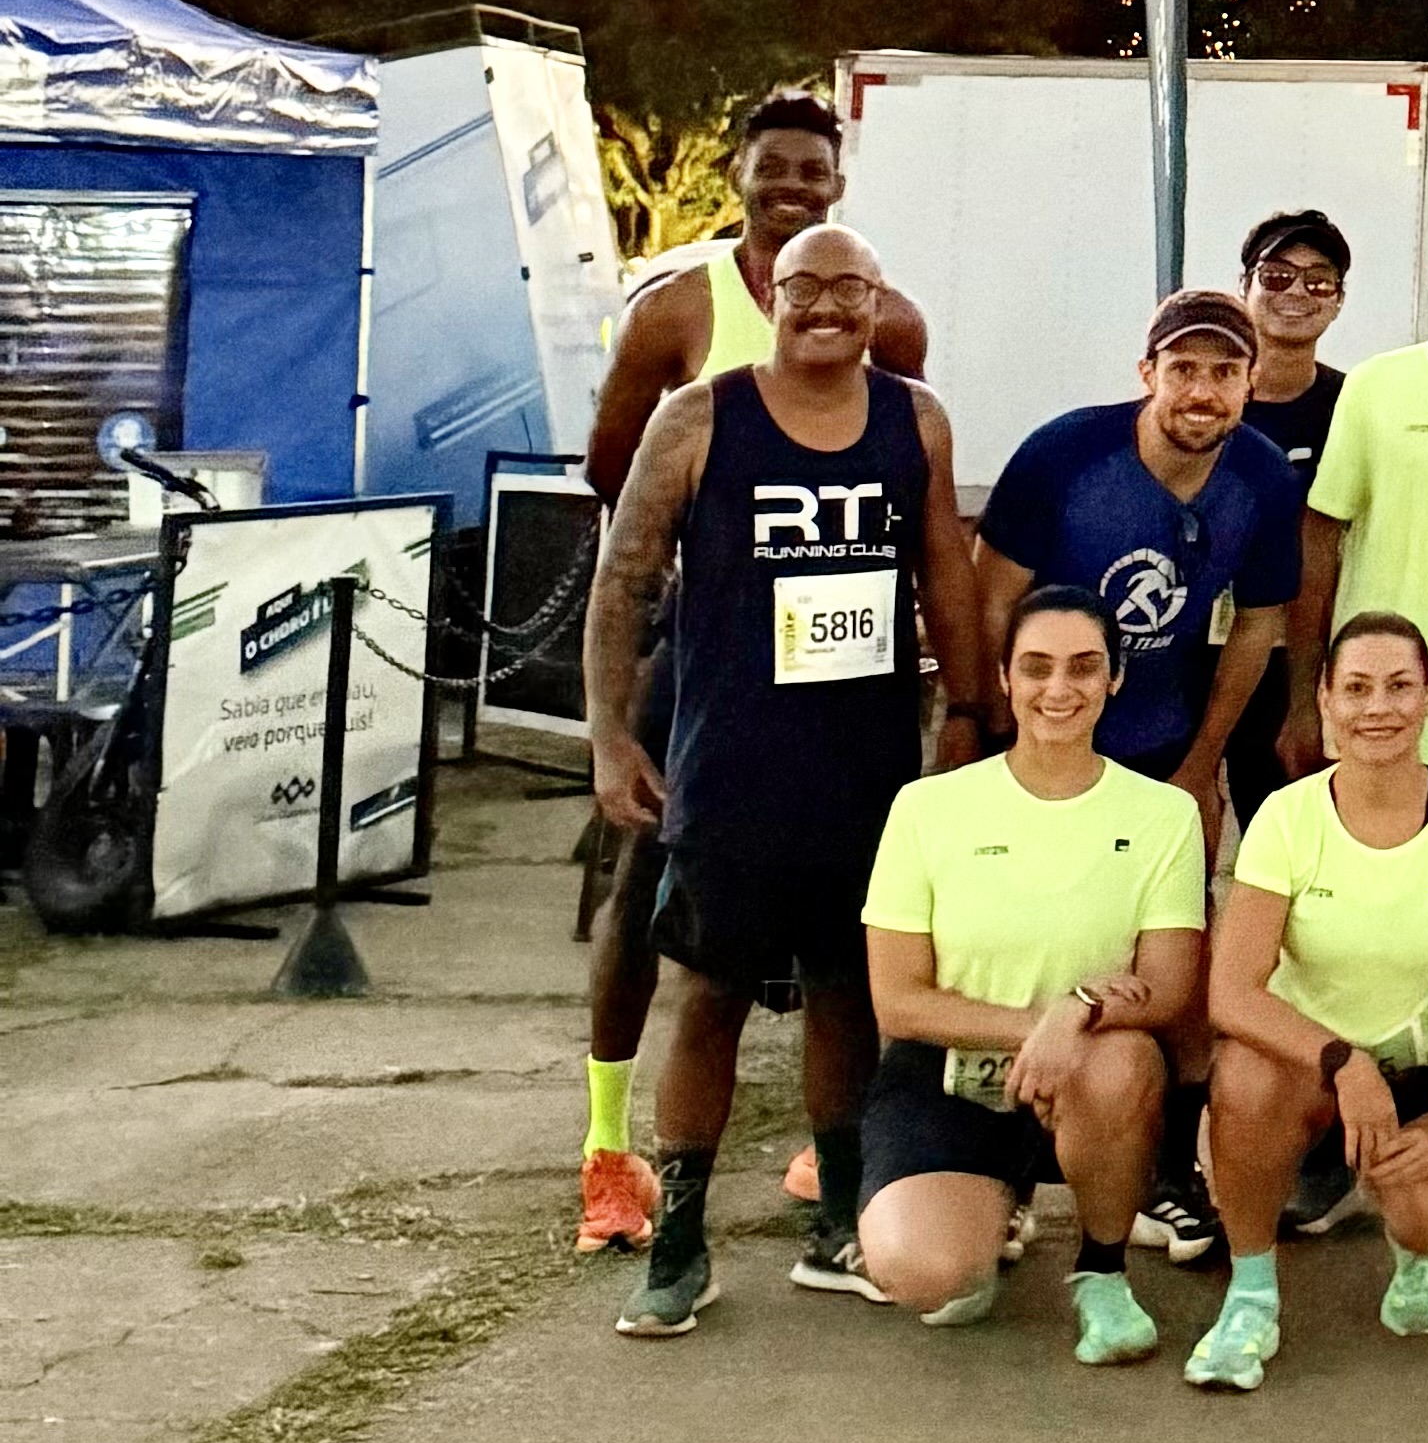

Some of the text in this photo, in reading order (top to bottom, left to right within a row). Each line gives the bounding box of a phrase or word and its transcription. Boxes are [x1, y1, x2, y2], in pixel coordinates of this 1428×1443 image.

[753, 543, 847, 559] RUNNING
[244, 640, 258, 660] O
[259, 608, 310, 651] CHORO
[810, 608, 874, 643] 5816
[219, 696, 270, 721] Sabia
[274, 693, 307, 717] que
[223, 708, 374, 752] veio porque uis!
